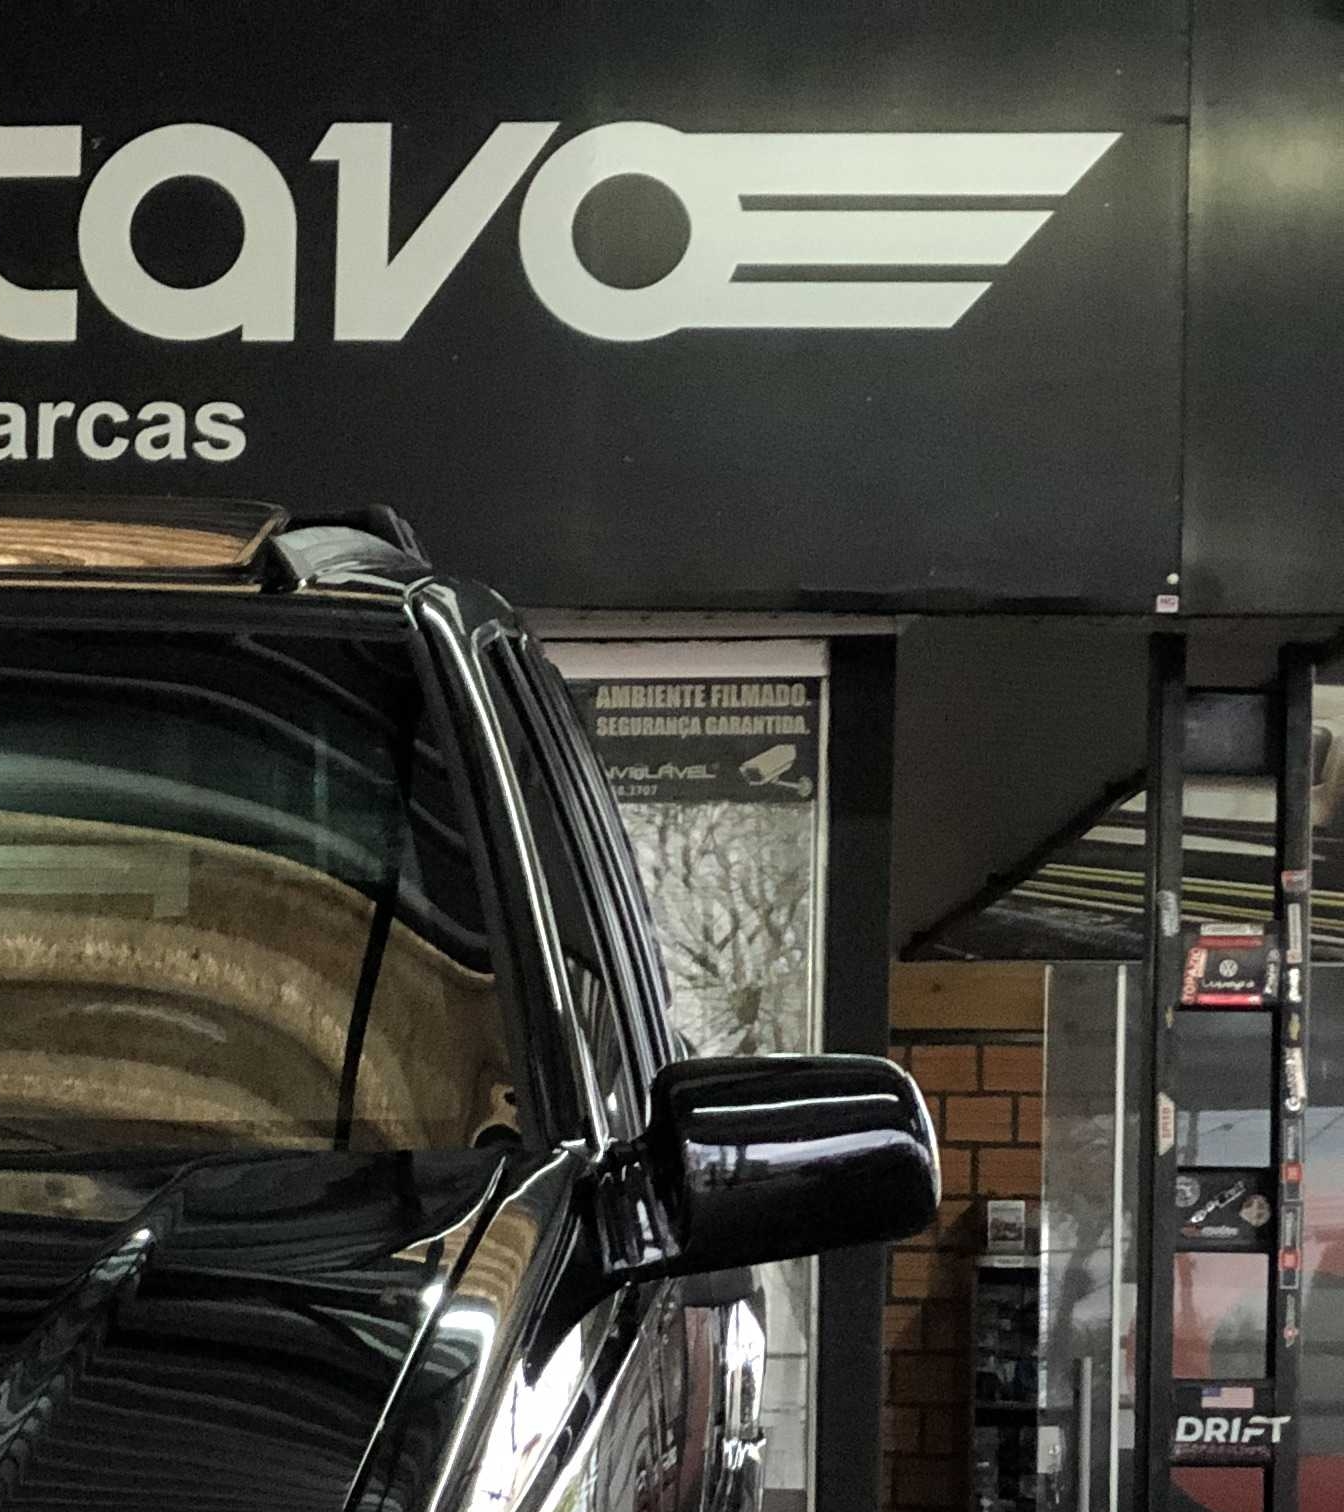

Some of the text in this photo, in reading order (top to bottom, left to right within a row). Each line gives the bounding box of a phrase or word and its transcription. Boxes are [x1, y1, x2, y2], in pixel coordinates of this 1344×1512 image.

[596, 683, 811, 709] AMBIENTE FILMADO.
[596, 716, 701, 739] SEGURANÇA
[1175, 1415, 1291, 1443] DRIFT
